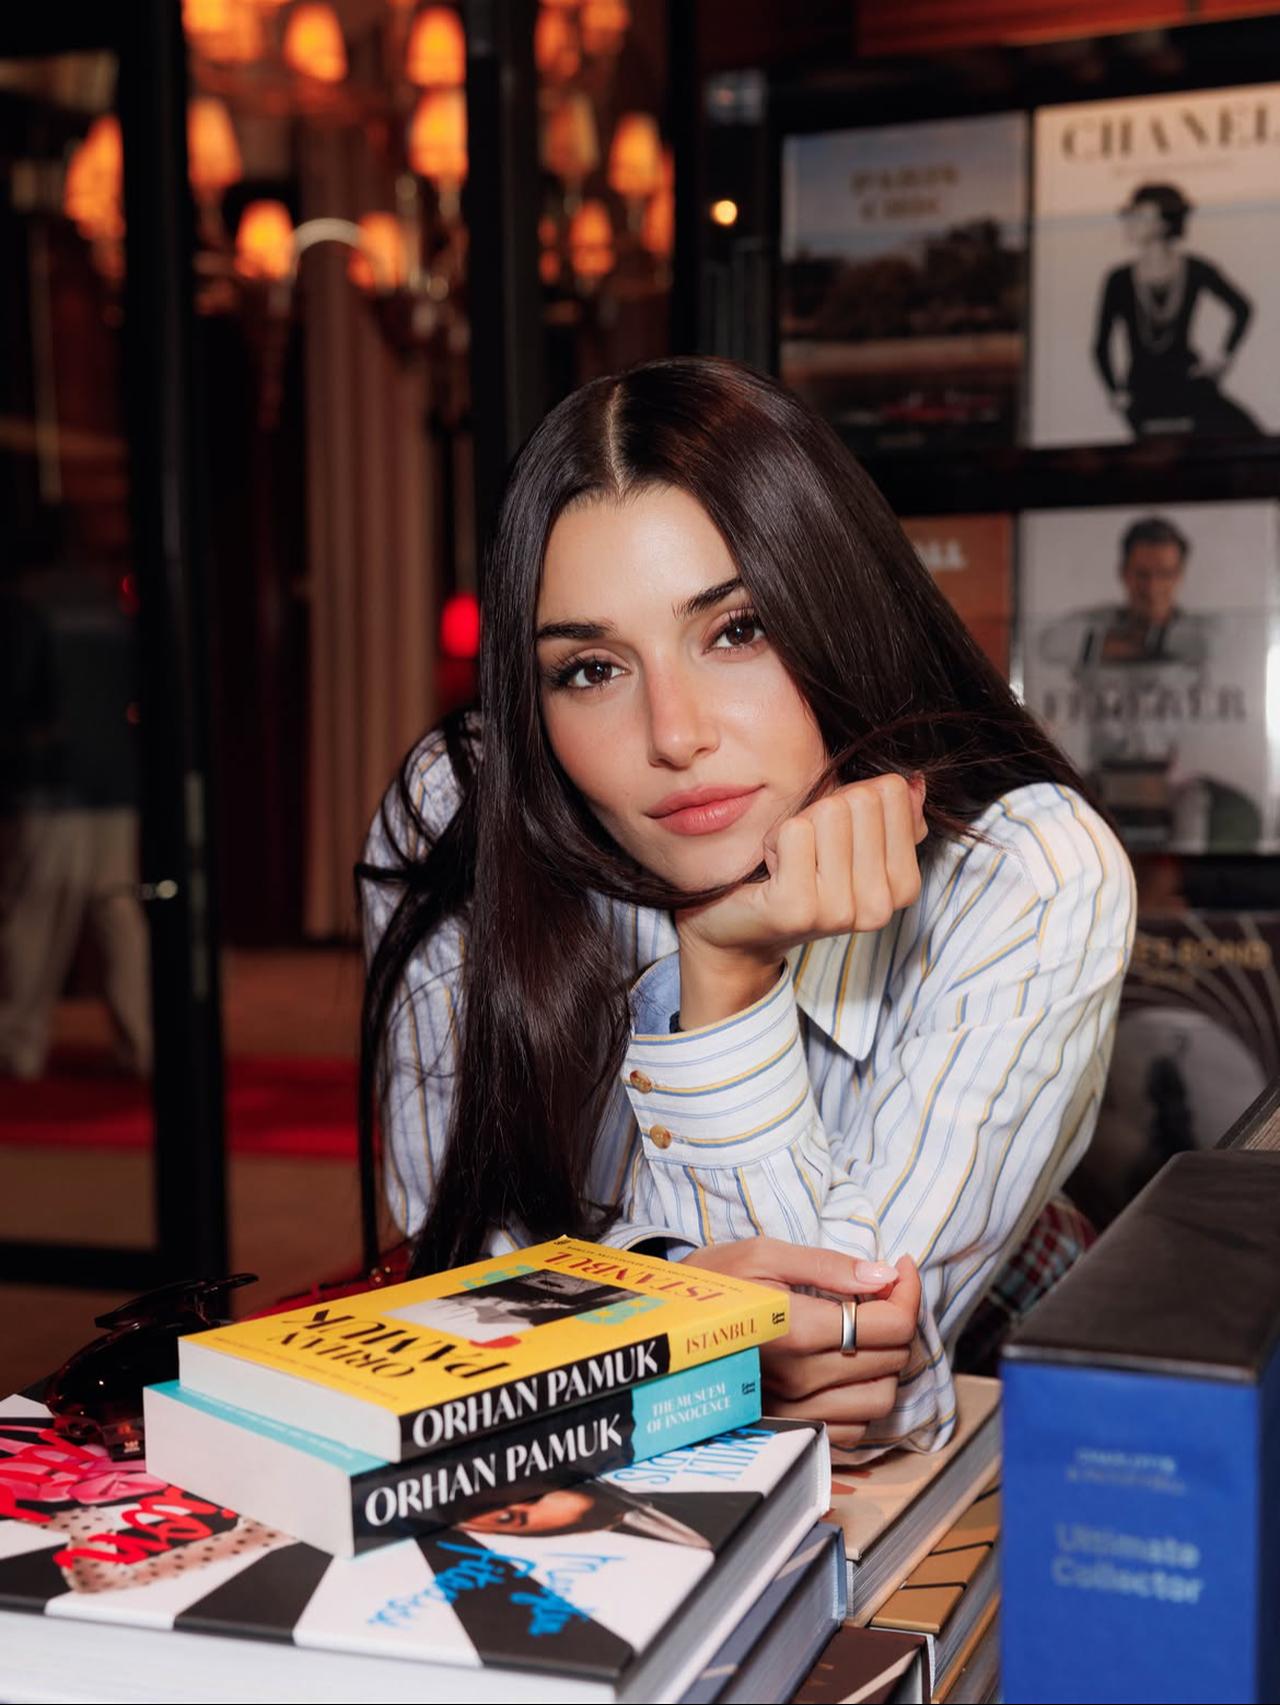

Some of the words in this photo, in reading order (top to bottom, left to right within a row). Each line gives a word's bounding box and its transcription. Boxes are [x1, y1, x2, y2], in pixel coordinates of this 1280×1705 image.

[1061, 104, 1280, 160] CHANEL
[544, 1252, 724, 1301] ISTANBUL
[266, 1331, 415, 1377] ORHAN
[282, 1309, 511, 1378] PAMUK
[686, 1318, 757, 1354] ISTANBUL
[412, 1377, 537, 1448] ORHAN
[548, 1341, 658, 1406] PAMUK
[646, 1419, 661, 1434] OF
[665, 1395, 731, 1429] INNOCENCE
[652, 1399, 673, 1417] THE
[365, 1453, 495, 1526] ORHAN
[506, 1413, 622, 1482] PAMUK
